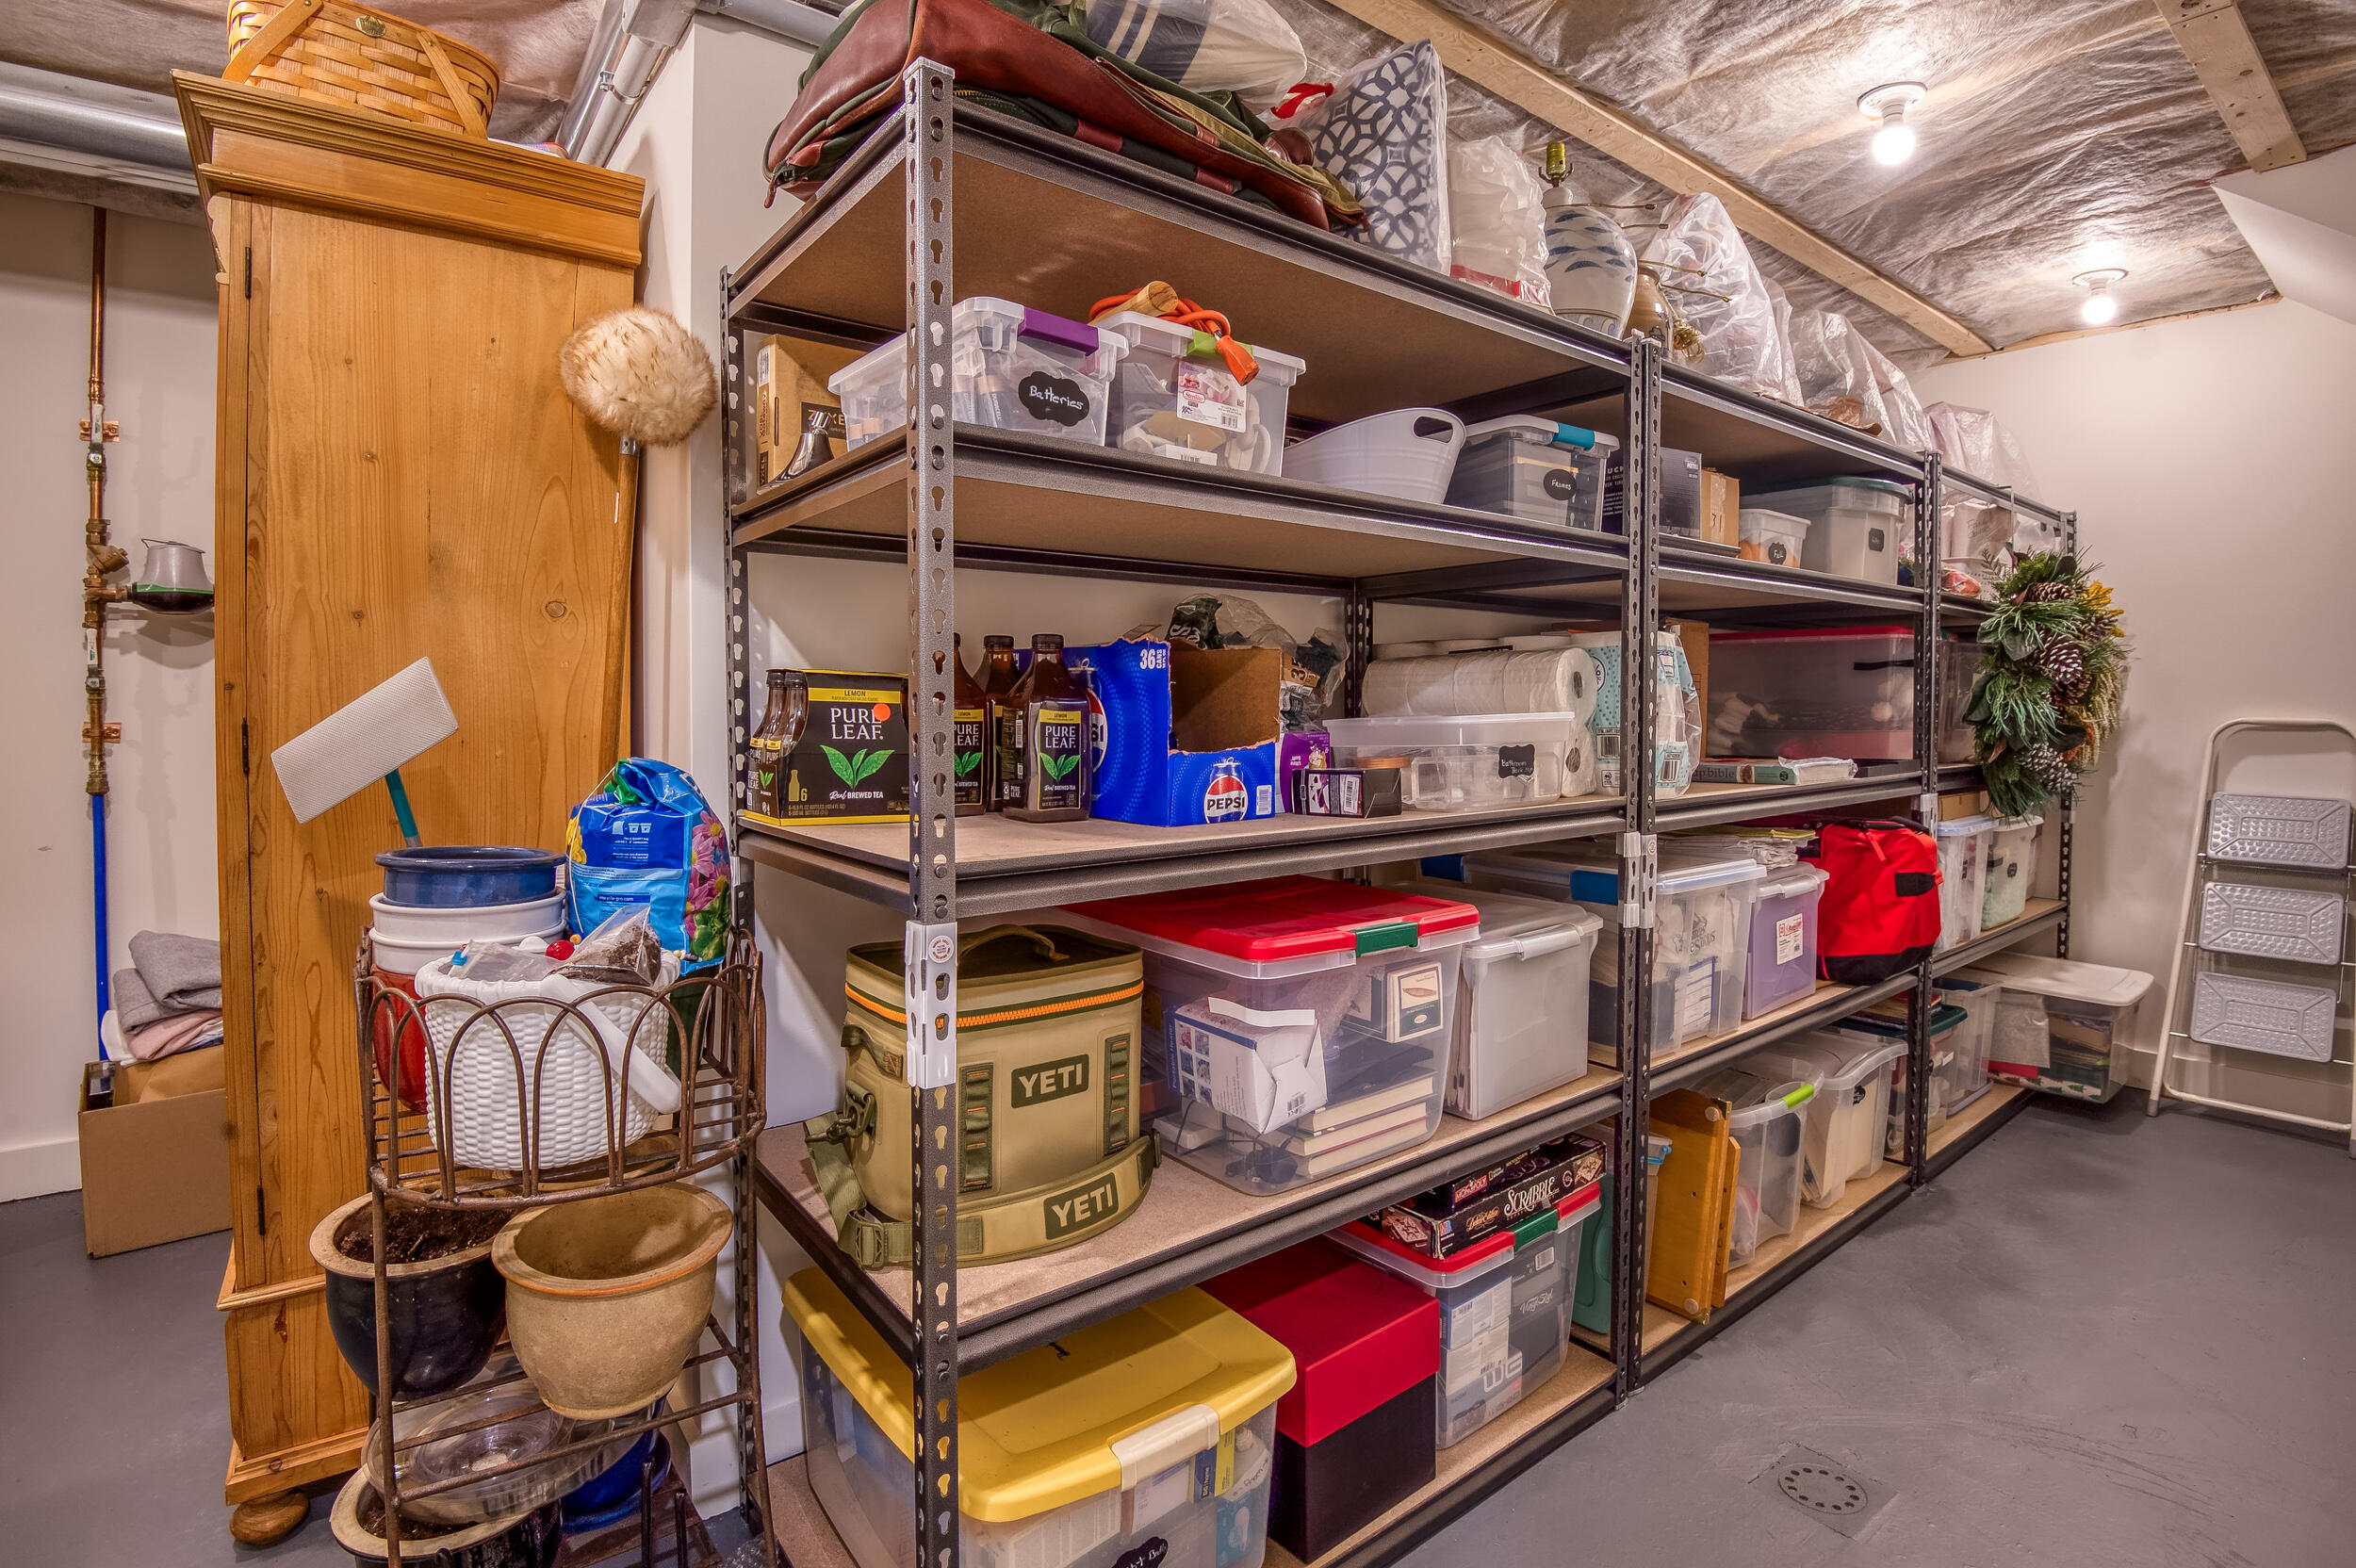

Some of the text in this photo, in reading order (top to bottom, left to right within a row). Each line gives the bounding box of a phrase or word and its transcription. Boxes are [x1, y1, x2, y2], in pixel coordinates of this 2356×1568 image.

[1029, 385, 1084, 410] Batteries
[1139, 648, 1155, 669] 36
[1045, 726, 1076, 737] PURE
[1708, 766, 1735, 778] bible
[800, 788, 808, 801] 6
[828, 790, 847, 800] Real
[847, 791, 873, 799] BREWED
[1207, 796, 1246, 810] PEPSI
[1018, 1062, 1083, 1099] YETI
[1455, 1176, 1488, 1202] MONOPOLY
[1504, 1177, 1556, 1216] SCRABBLE
[1051, 1183, 1114, 1228] YETI
